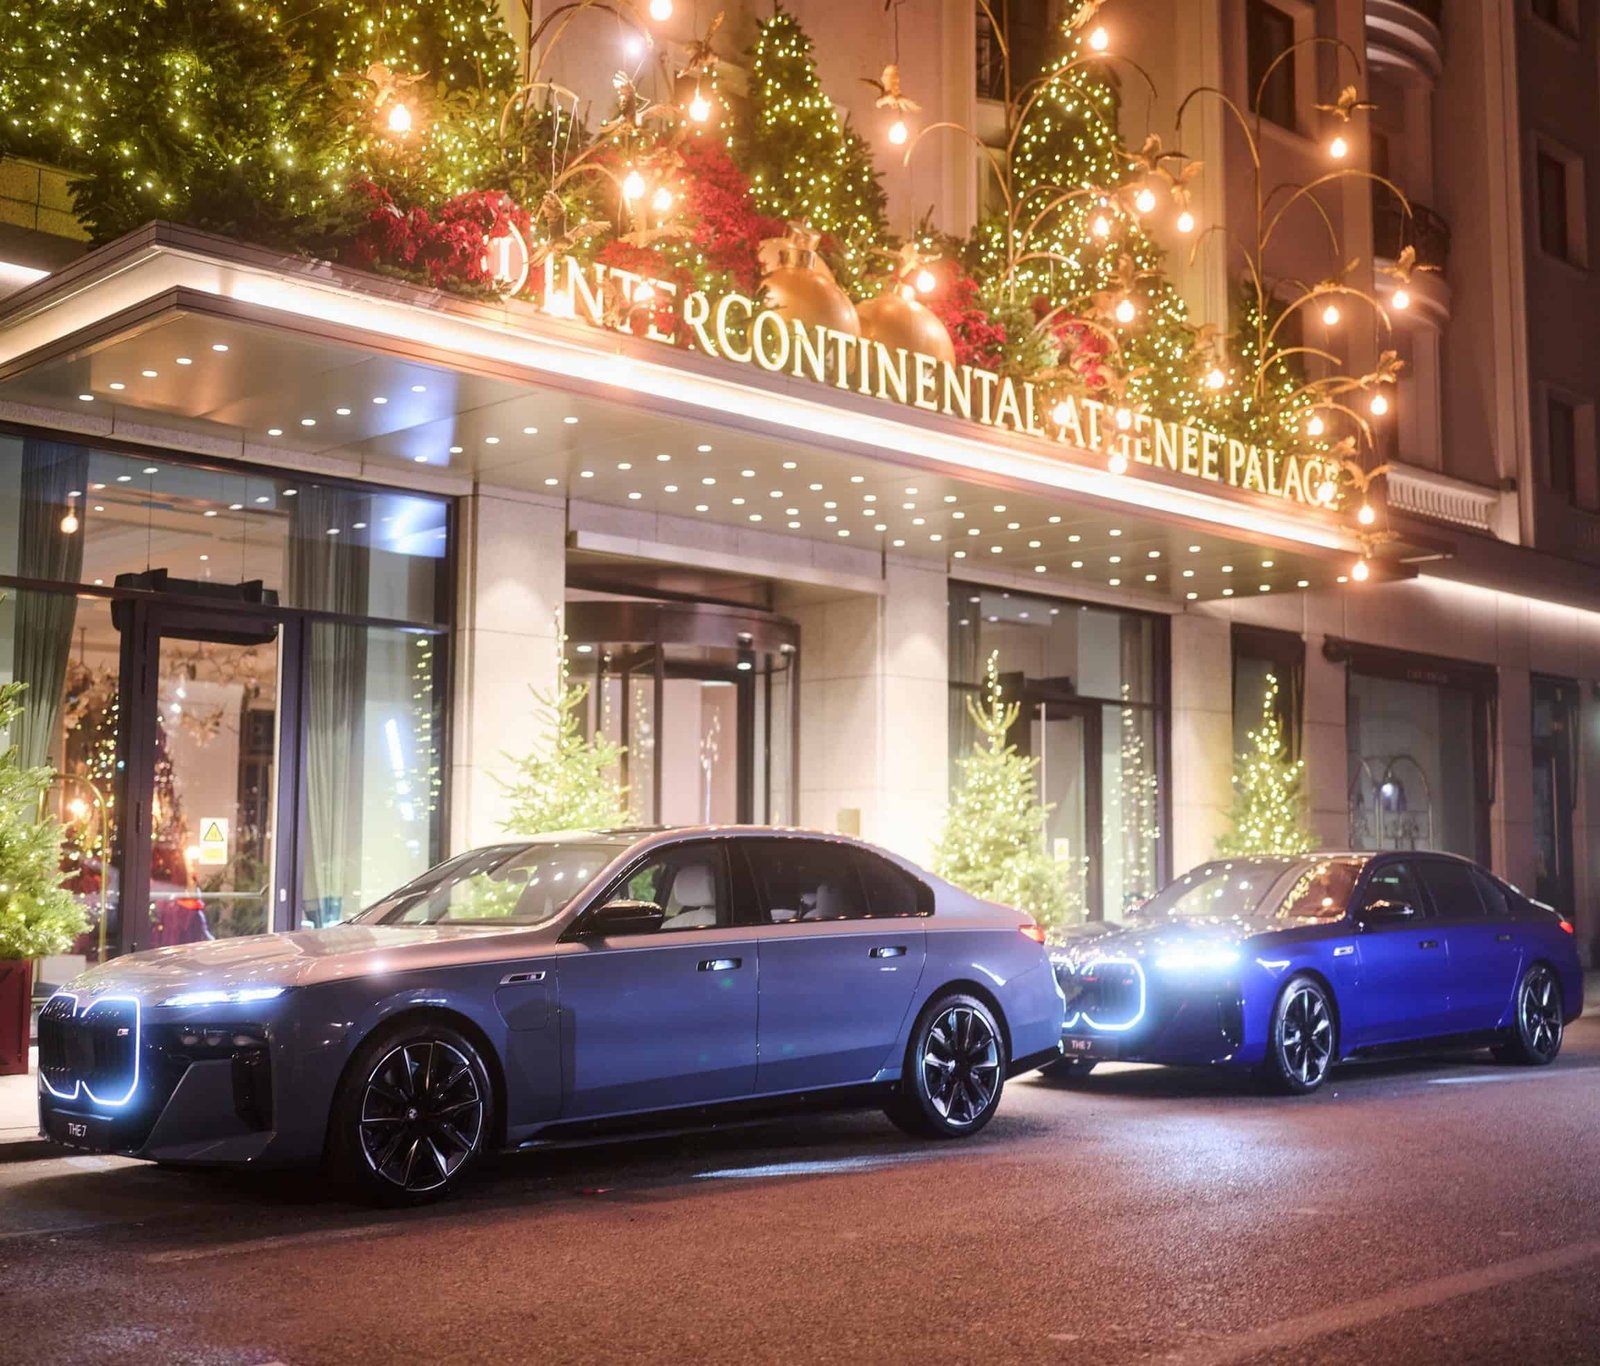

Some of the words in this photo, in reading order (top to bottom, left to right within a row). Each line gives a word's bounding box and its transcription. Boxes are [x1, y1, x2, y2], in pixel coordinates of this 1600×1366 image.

[1228, 438, 1340, 512] PALACE
[1071, 1039, 1086, 1050] THE
[1086, 1040, 1093, 1051] 7
[67, 1122, 82, 1137] THE
[82, 1124, 88, 1138] 7
